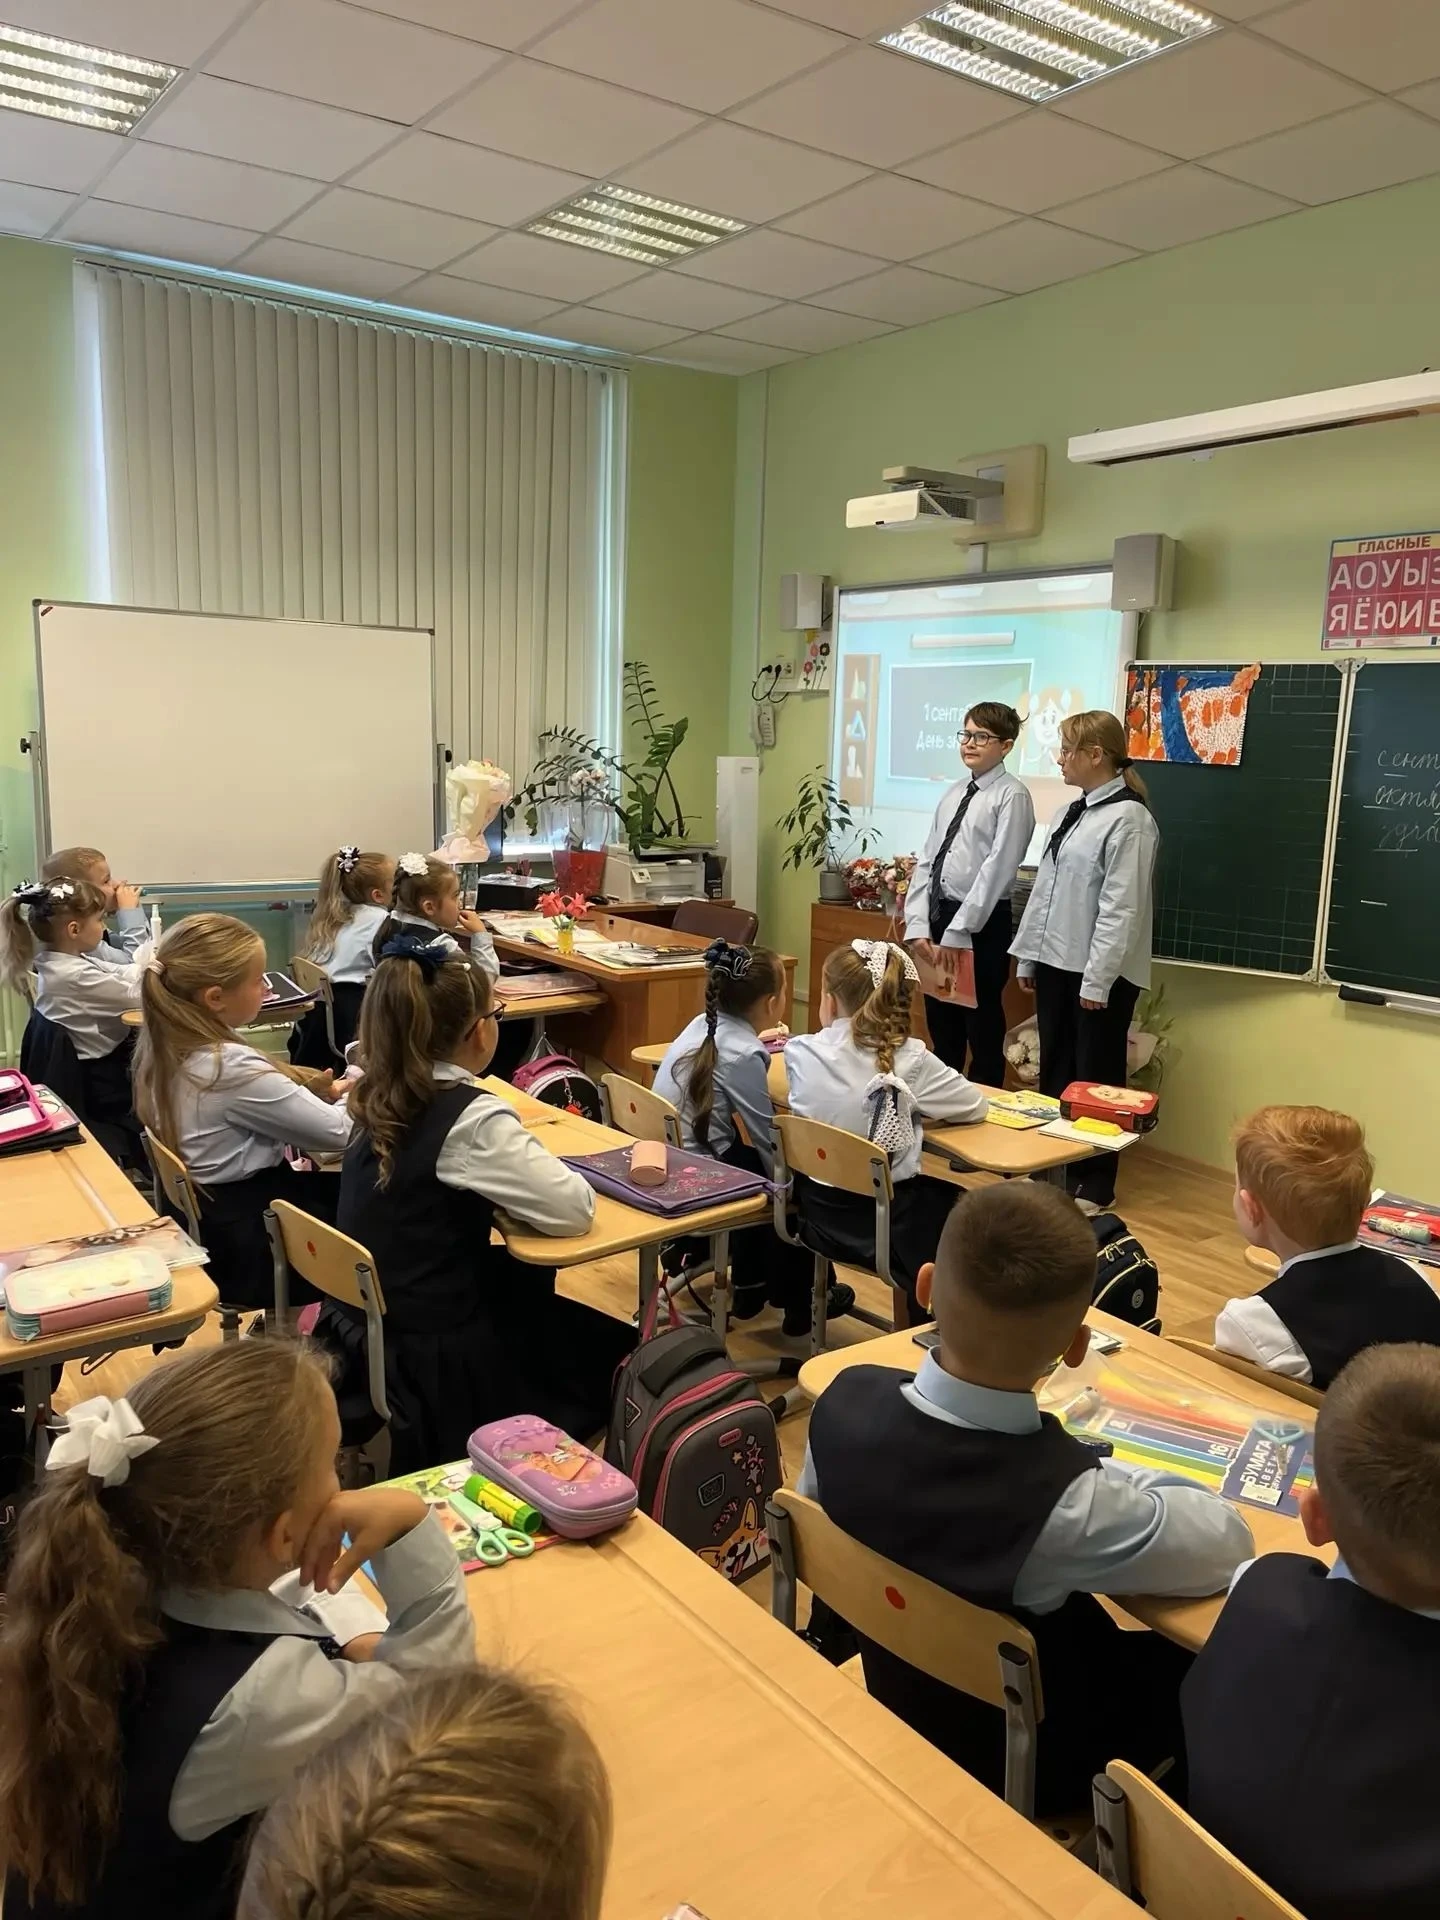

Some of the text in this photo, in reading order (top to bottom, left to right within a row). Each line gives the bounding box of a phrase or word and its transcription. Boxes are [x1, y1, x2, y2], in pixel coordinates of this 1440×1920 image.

[1358, 536, 1431, 553] ГЛАСНЫЕ
[916, 730, 944, 752] День
[1208, 1443, 1229, 1456] 16
[1240, 1439, 1273, 1486] БУМАГА
[1258, 1450, 1278, 1489] ЦВЕТН
